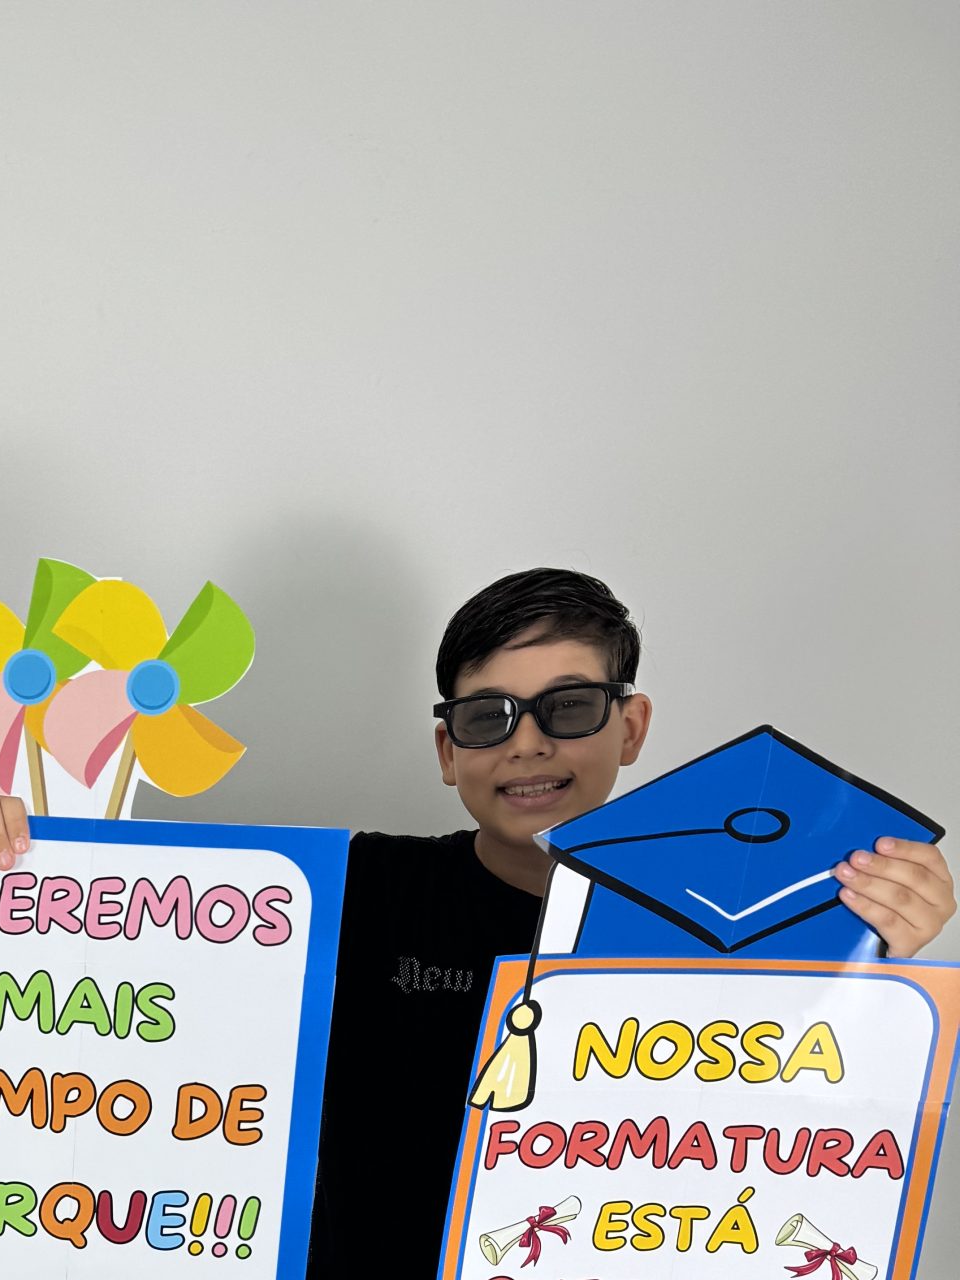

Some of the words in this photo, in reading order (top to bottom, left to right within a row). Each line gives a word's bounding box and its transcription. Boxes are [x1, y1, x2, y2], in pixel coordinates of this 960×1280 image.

[573, 1017, 845, 1084] NOSSA
[171, 1081, 268, 1145] DE
[483, 1116, 906, 1180] FORMATURA
[592, 1187, 759, 1254] ESTÁ
